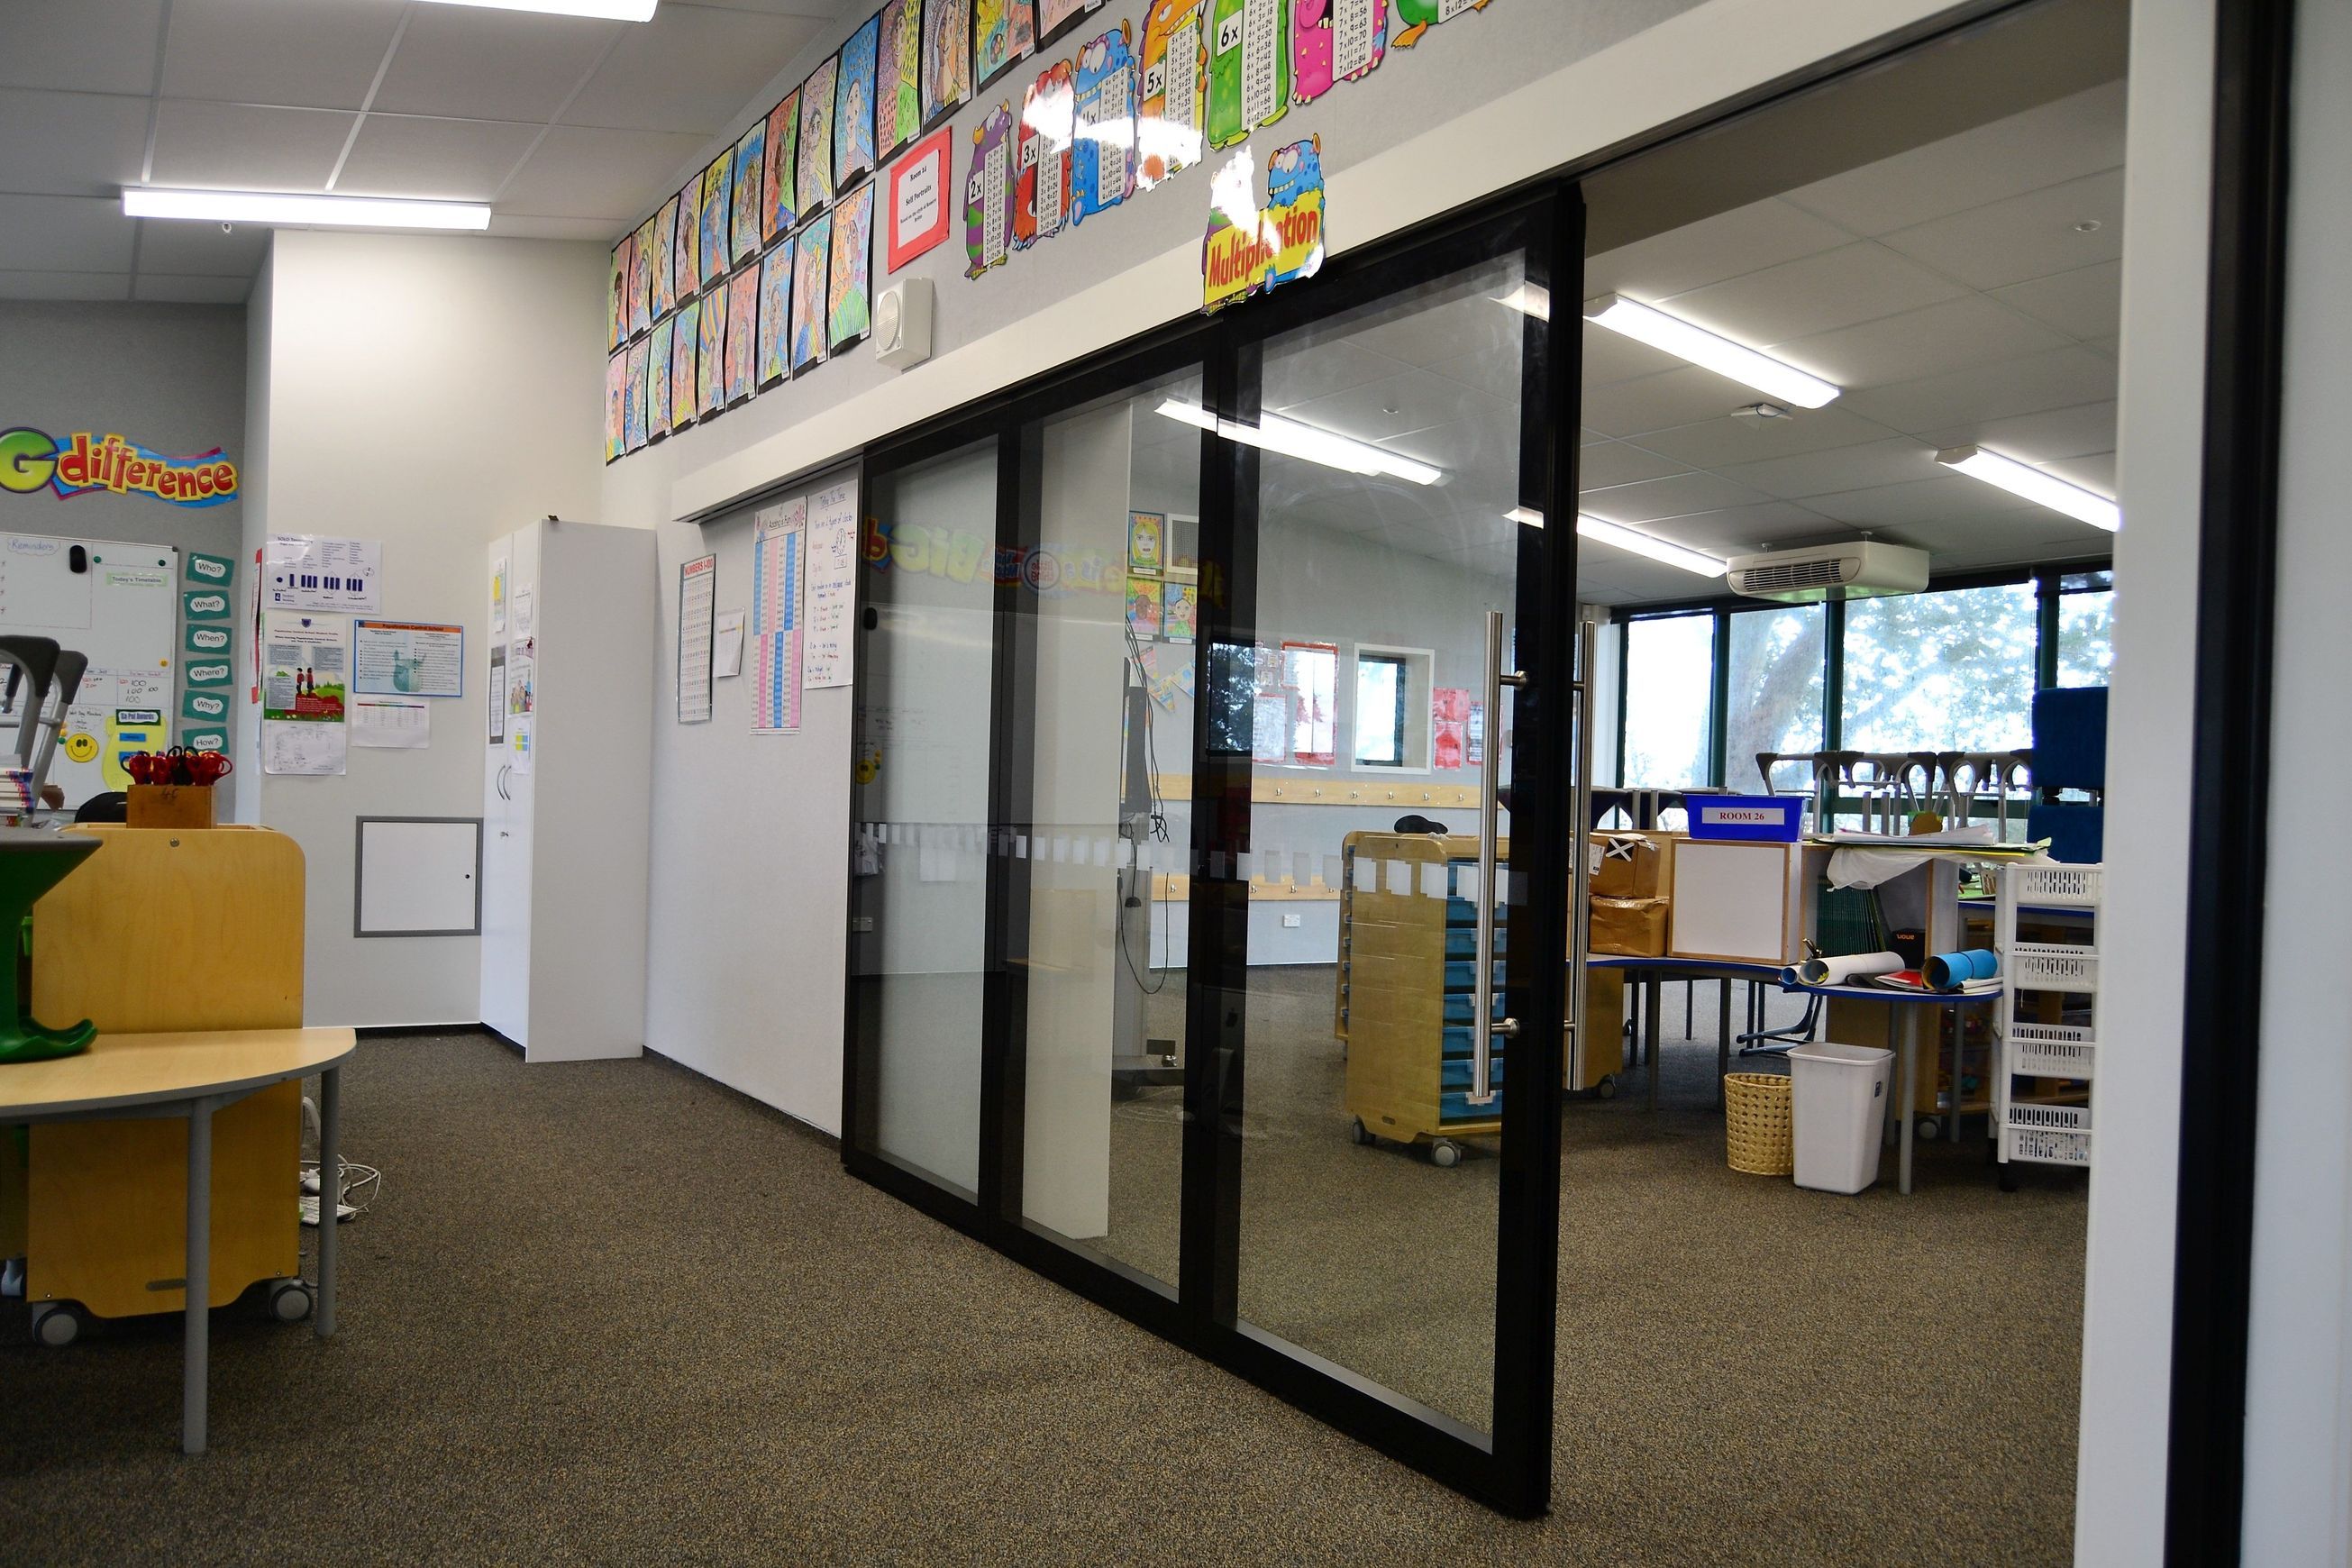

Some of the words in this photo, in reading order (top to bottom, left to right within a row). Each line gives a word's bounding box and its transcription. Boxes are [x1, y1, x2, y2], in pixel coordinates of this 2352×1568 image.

[1221, 25, 1238, 47] 6x
[1147, 72, 1162, 94] 5x
[1024, 145, 1036, 162] 3x
[910, 170, 921, 181] Room
[914, 185, 932, 201] Portraits
[971, 181, 981, 197] 2x
[59, 434, 235, 498] difference
[198, 562, 222, 573] Who?
[112, 576, 133, 584] Today's
[194, 600, 220, 608] What?
[196, 633, 224, 643] When?
[194, 668, 224, 677] Where?
[196, 700, 220, 710] Why?
[196, 738, 218, 746] How?
[1719, 812, 1751, 820] ROOM
